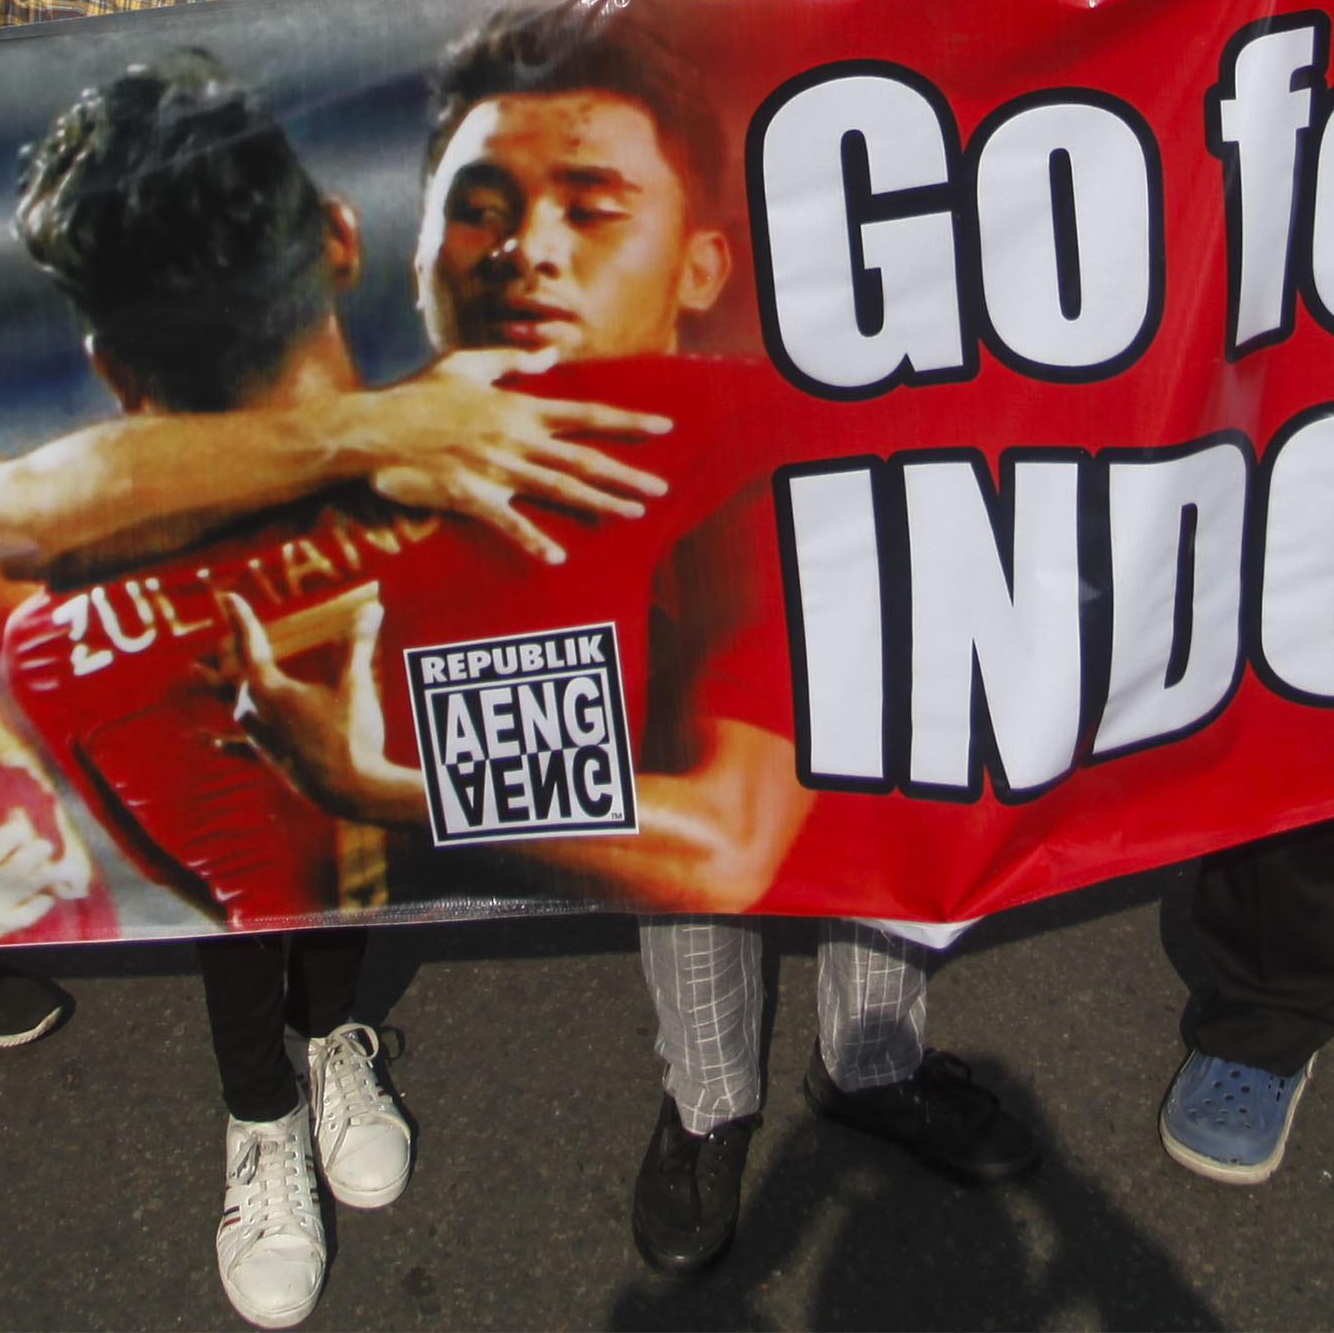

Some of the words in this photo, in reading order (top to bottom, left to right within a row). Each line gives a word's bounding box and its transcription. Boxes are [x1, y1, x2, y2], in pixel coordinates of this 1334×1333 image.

[749, 62, 1161, 398] Go
[420, 634, 606, 685] REPUBLIK
[444, 676, 607, 766] AENG
